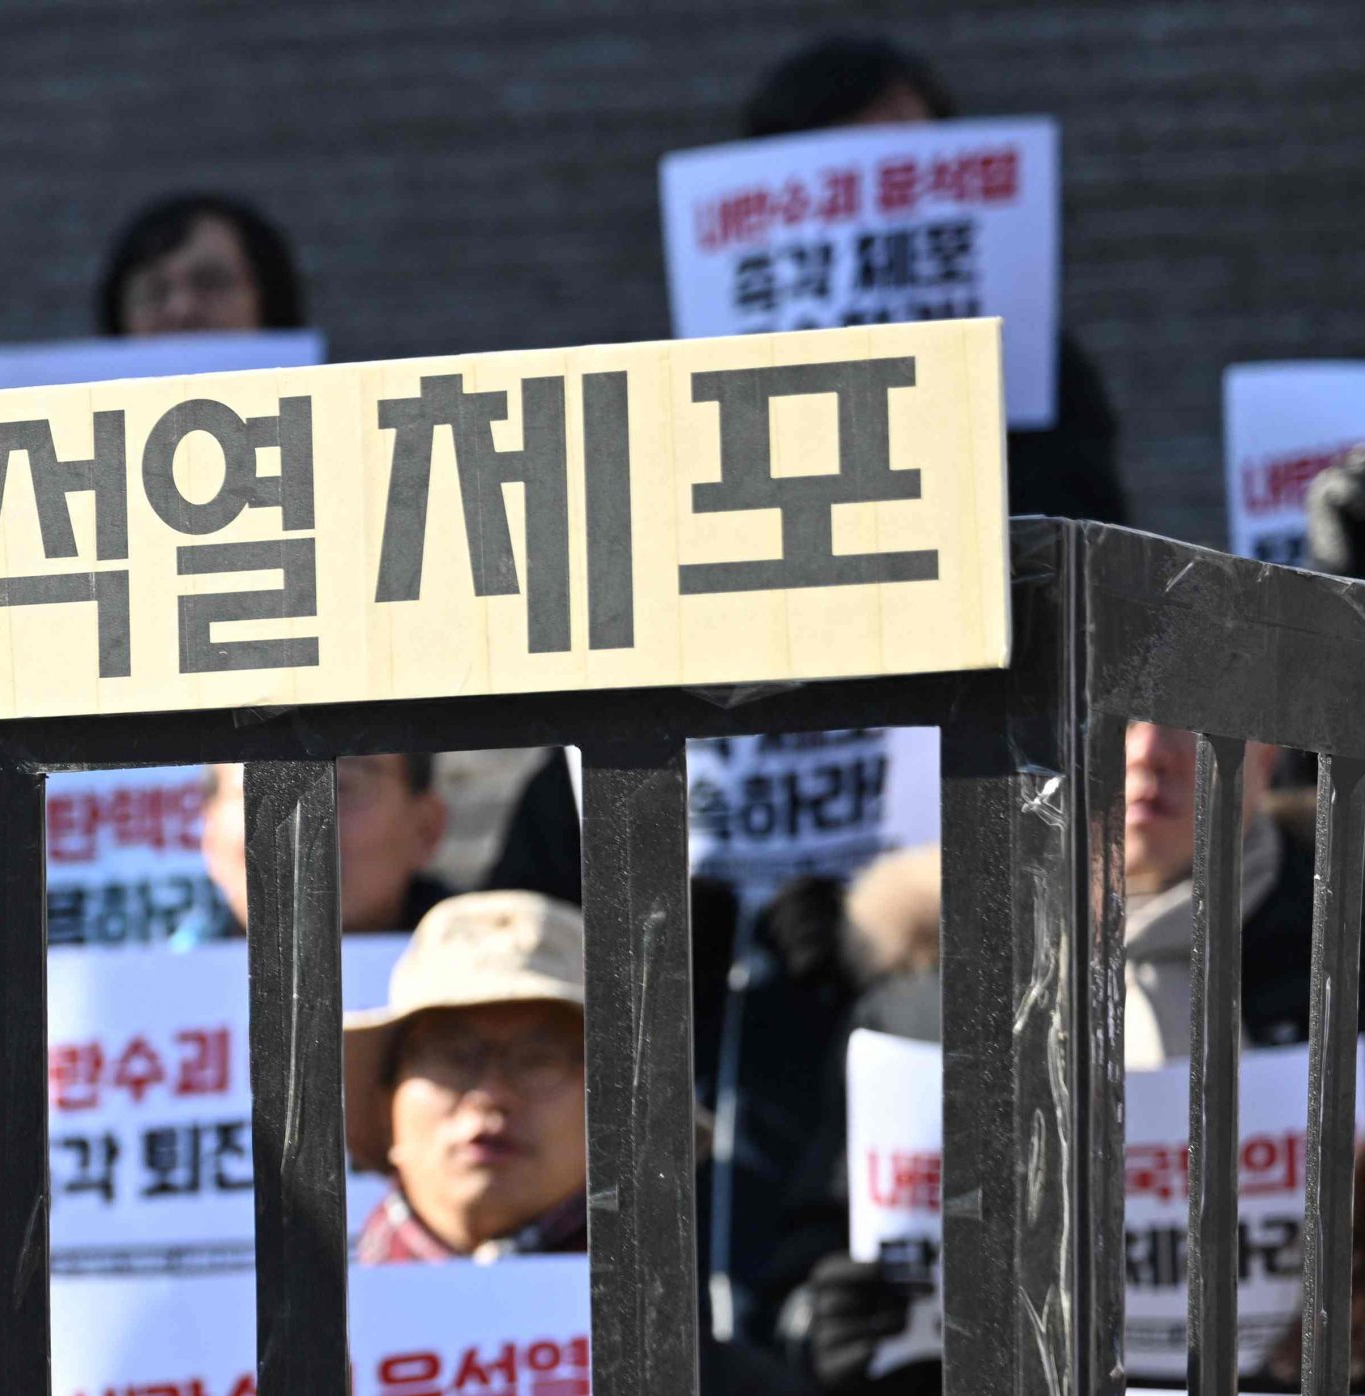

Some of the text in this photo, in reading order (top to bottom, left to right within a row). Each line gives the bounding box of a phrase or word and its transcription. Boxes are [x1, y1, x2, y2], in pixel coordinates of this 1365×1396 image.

[877, 148, 1019, 211] 윤석열
[734, 217, 978, 314] 즉각 체포
